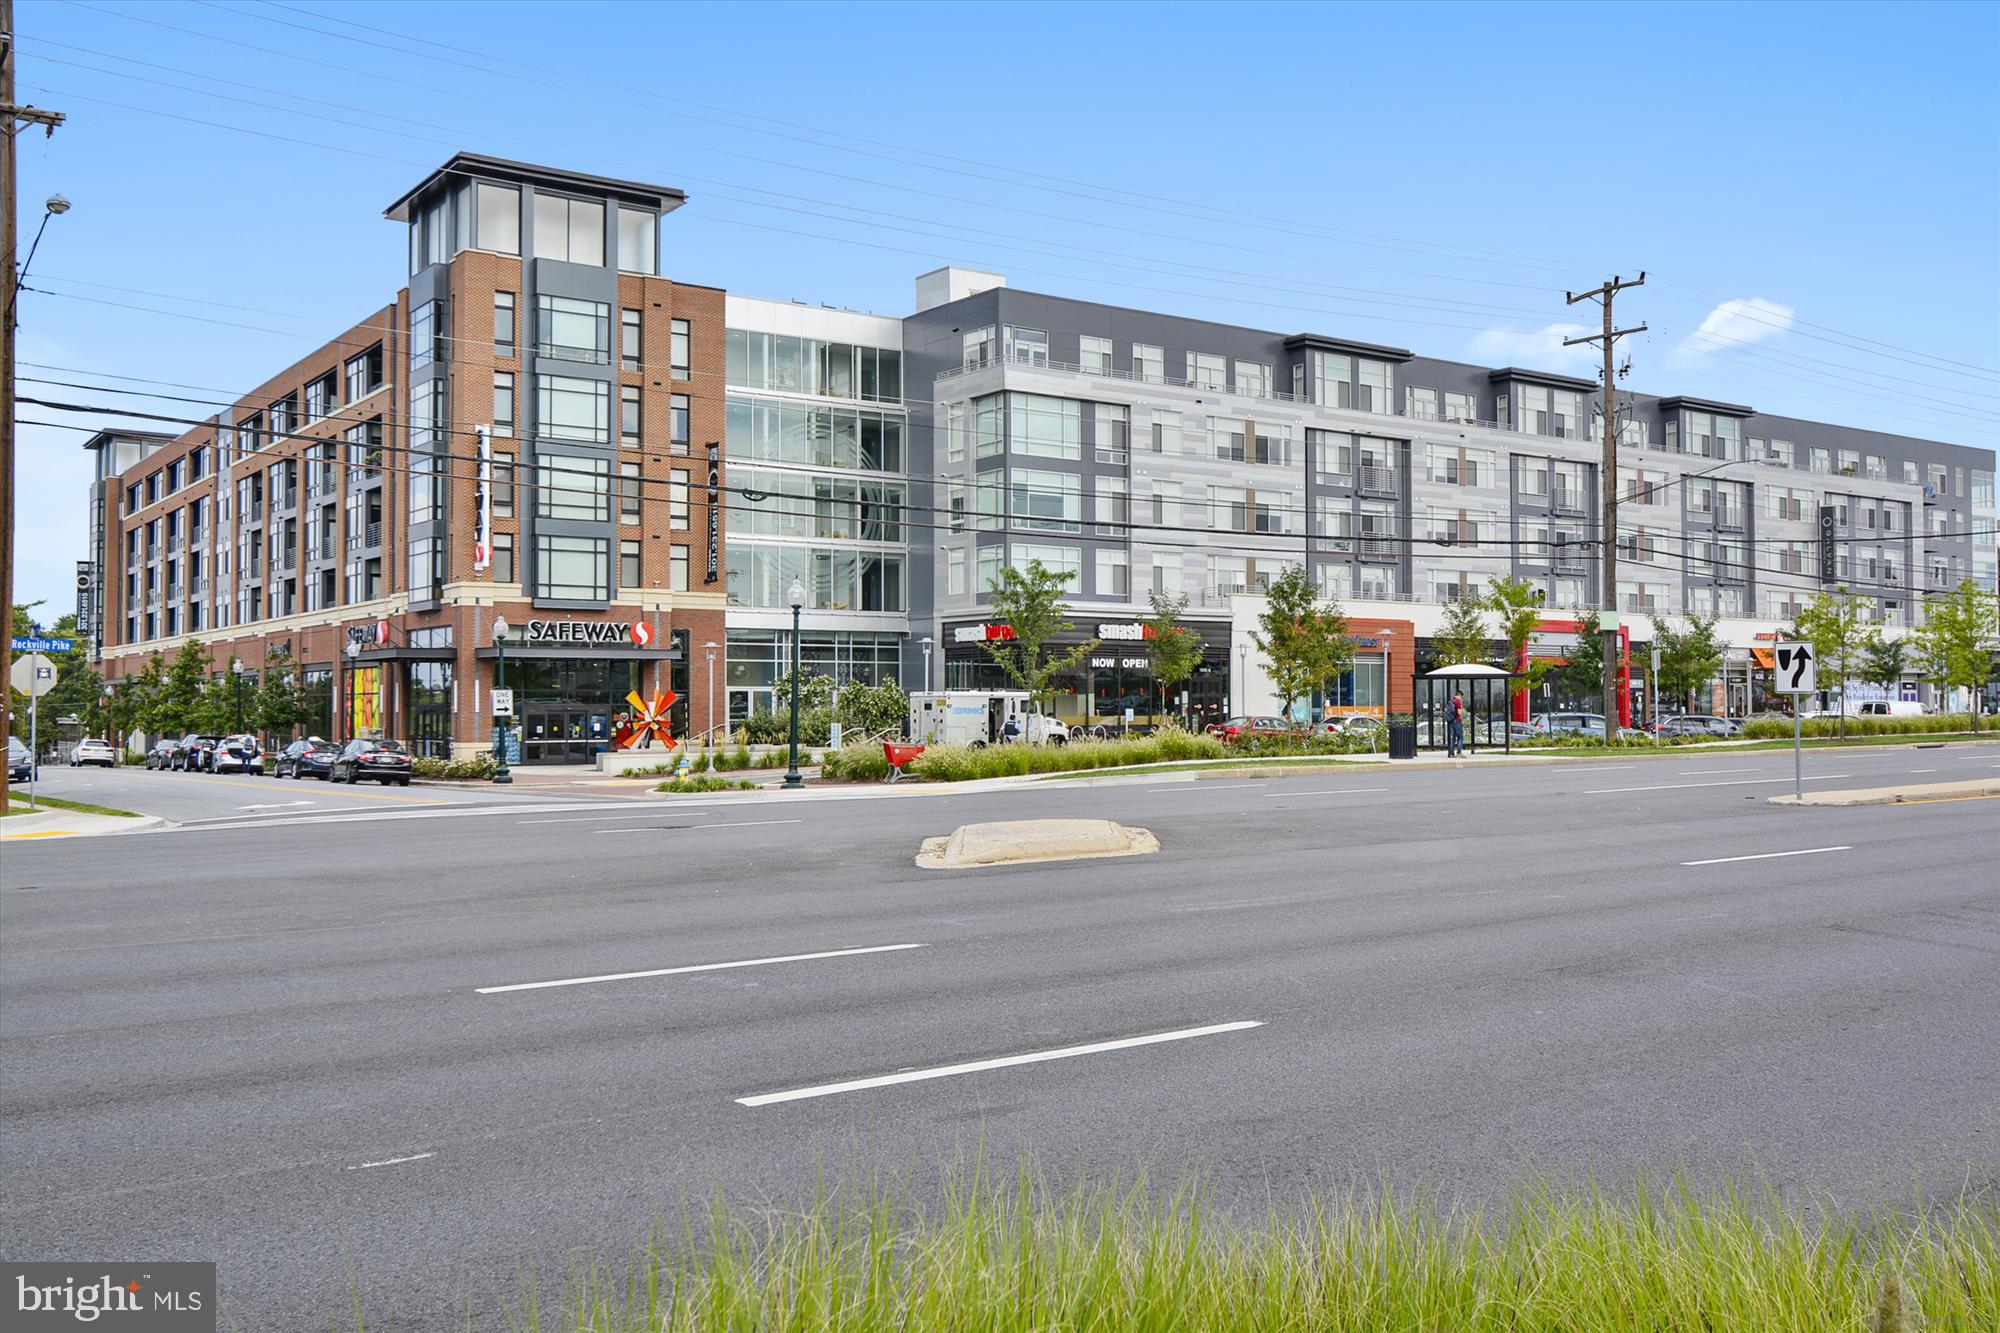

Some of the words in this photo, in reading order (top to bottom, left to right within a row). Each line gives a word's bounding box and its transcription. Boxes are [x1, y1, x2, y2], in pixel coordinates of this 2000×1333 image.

[528, 619, 631, 643] SAFEWAY
[11, 639, 51, 650] Rockville
[52, 640, 71, 650] Pike
[1092, 658, 1115, 668] NOW
